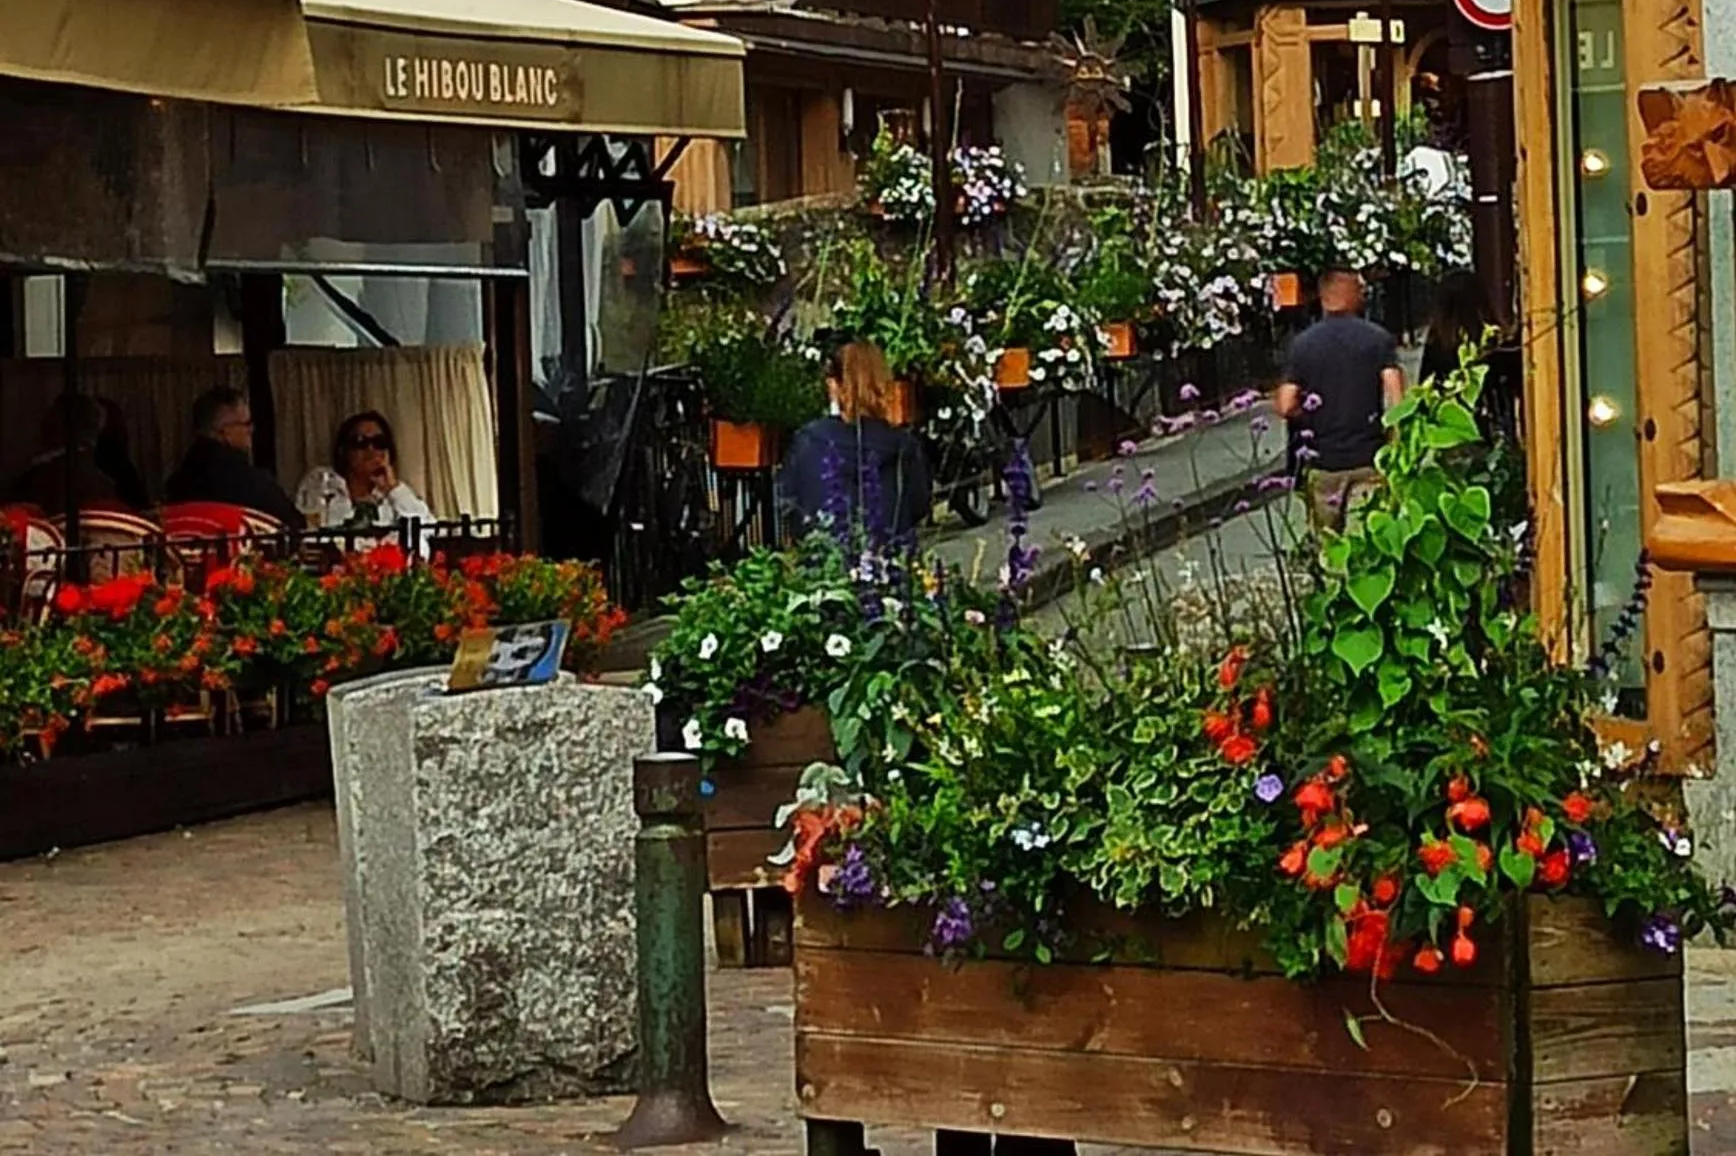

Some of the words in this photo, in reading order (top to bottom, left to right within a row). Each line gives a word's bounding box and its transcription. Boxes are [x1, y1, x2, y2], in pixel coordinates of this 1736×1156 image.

[385, 57, 408, 96] LE
[414, 57, 484, 100] HIBOU
[489, 64, 557, 105] BLANC
